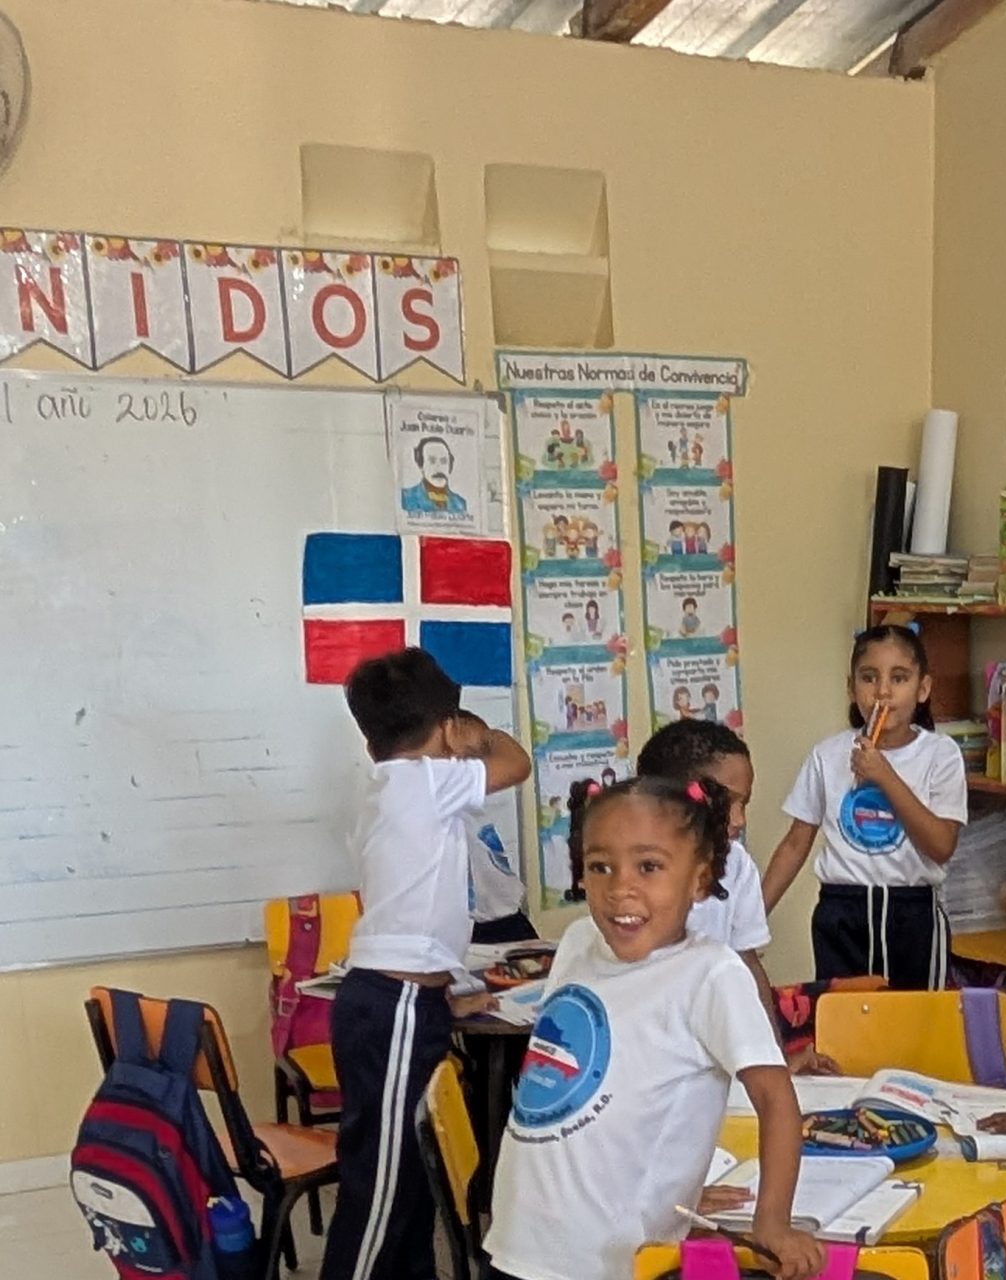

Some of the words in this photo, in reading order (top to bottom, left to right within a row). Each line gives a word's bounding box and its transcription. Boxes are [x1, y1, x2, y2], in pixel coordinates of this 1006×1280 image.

[506, 362, 575, 382] Nuestras
[639, 365, 656, 382] de
[660, 366, 738, 386] Convivencia
[115, 391, 198, 427] 2026
